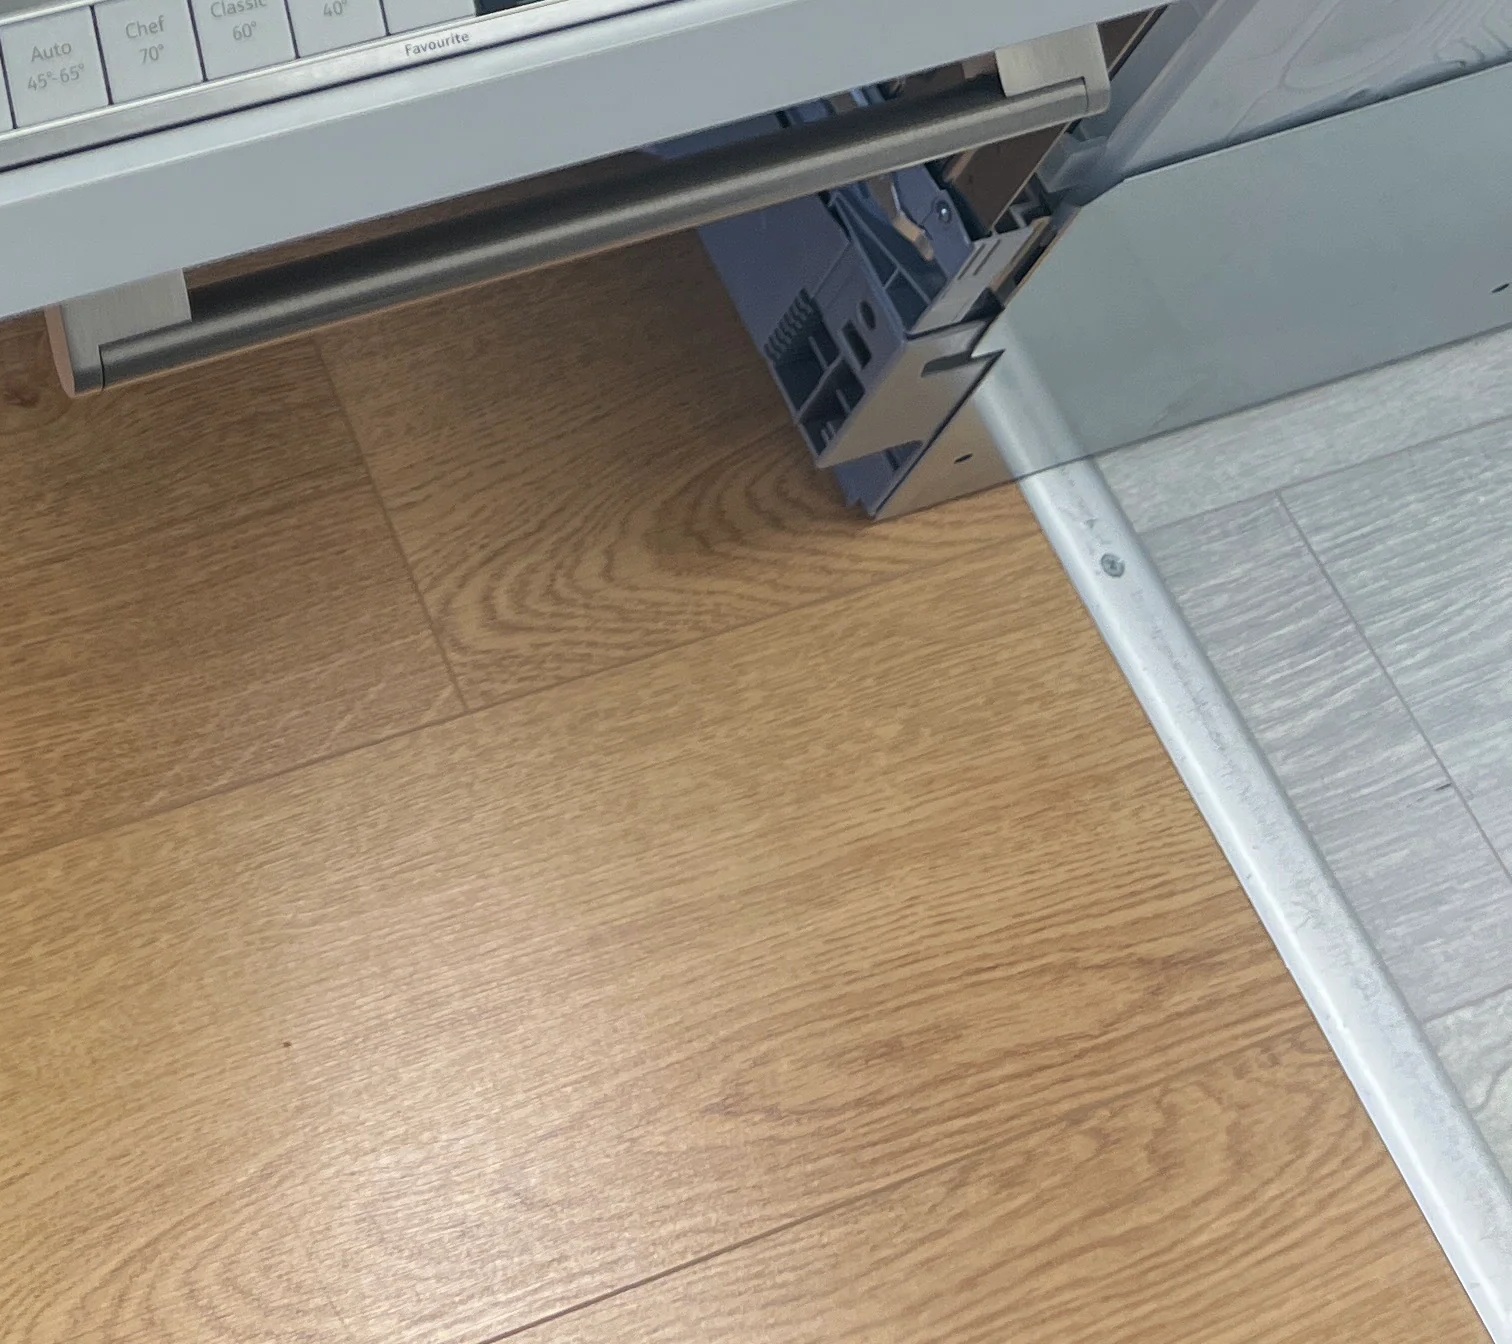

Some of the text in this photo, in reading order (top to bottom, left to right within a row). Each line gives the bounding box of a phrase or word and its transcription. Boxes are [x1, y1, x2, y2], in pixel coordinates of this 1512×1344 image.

[126, 16, 164, 39] Chef
[232, 20, 257, 41] 60°
[31, 39, 72, 62] Auto
[139, 44, 164, 64] 70°
[404, 31, 469, 56] Favourite
